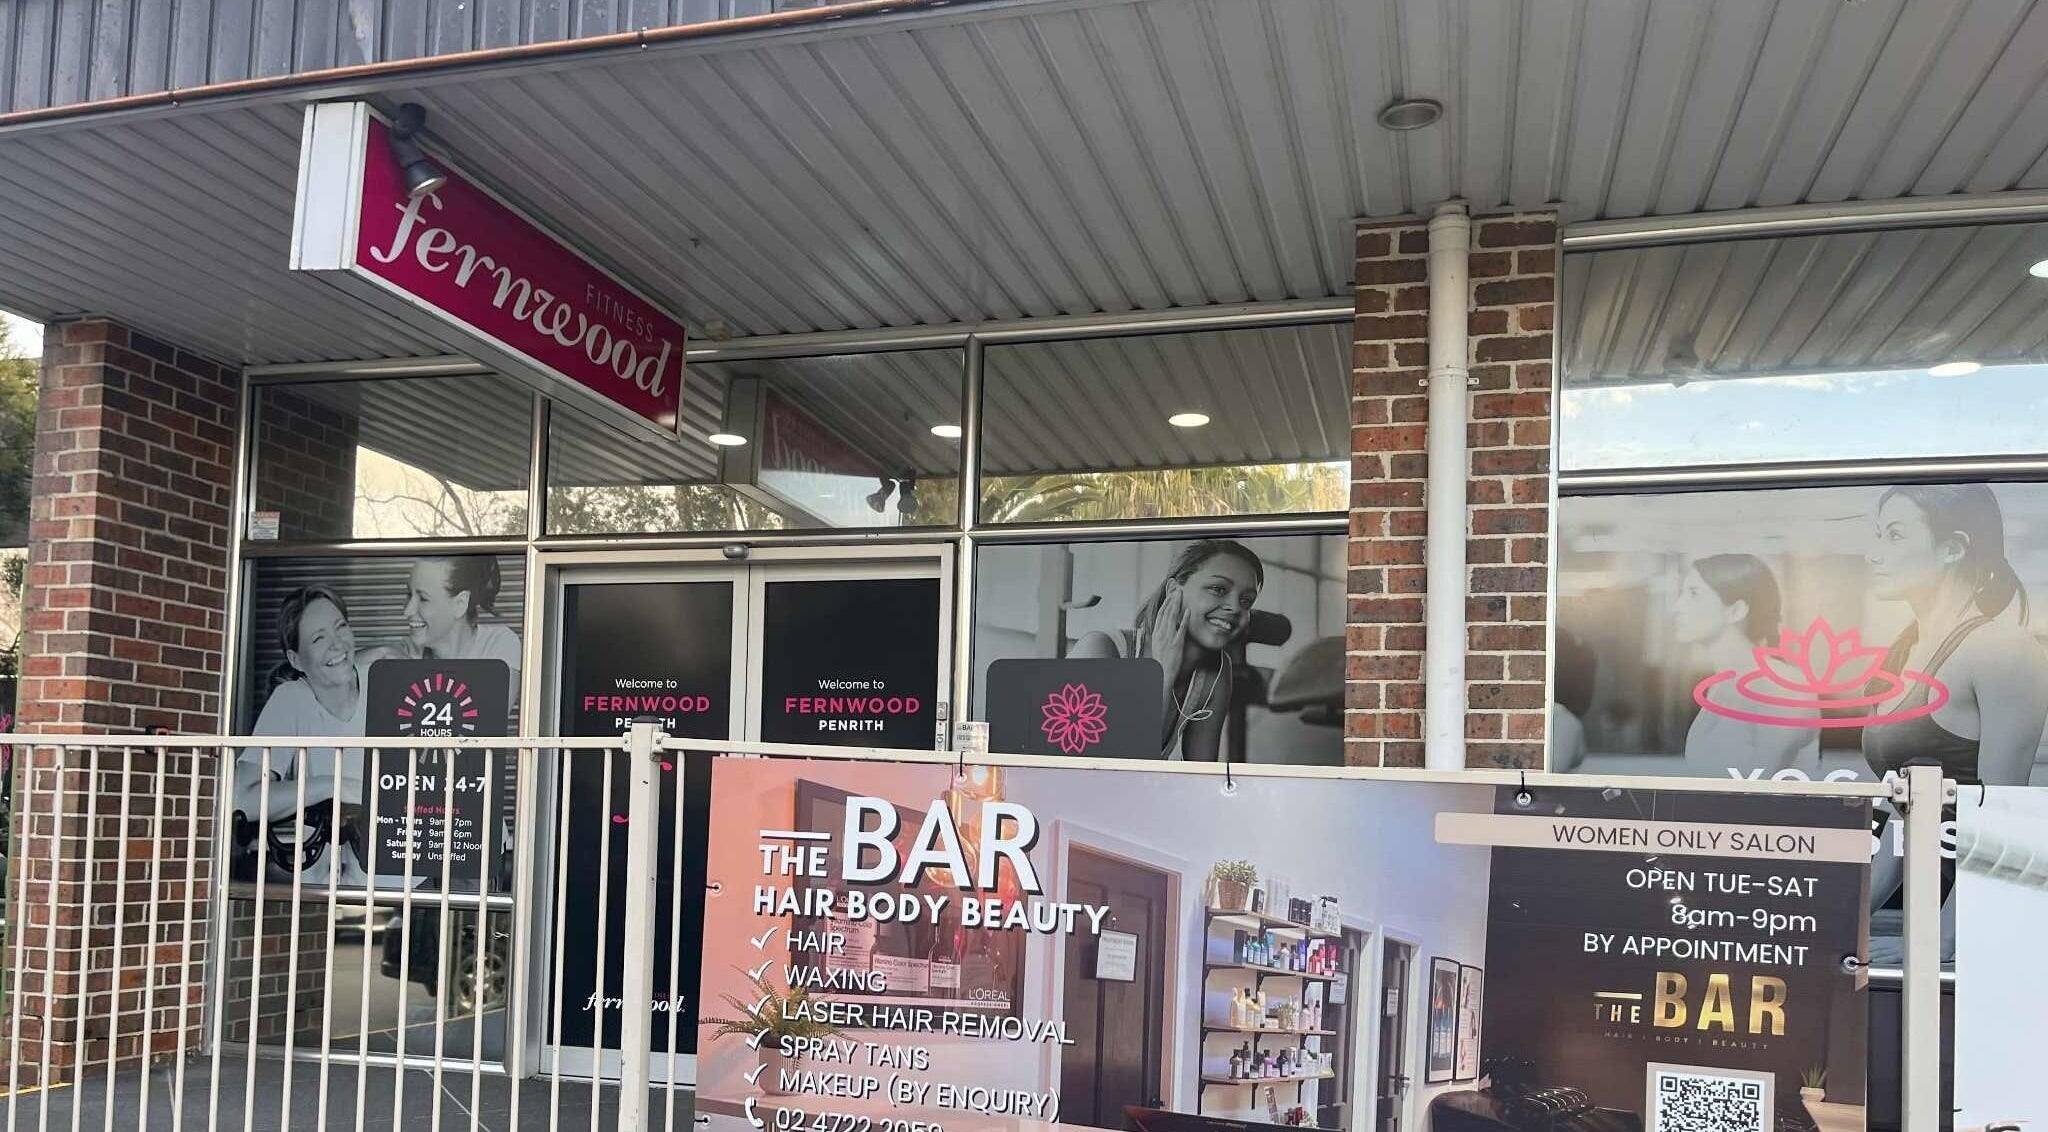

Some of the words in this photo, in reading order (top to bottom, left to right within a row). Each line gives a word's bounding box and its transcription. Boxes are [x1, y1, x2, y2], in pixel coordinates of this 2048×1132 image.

[370, 191, 672, 398] fernwood
[586, 283, 654, 343] FITNESS
[615, 678, 664, 689] Welcome
[666, 679, 678, 689] to
[818, 679, 870, 690] Welcome
[873, 680, 885, 690] to
[420, 702, 453, 726] 24
[584, 696, 710, 712] FERNWOOD
[785, 697, 920, 714] FERNWOOD
[420, 728, 453, 737] HOURS
[615, 718, 676, 729] PETH
[819, 719, 884, 731] PENRITH
[443, 776, 485, 792] 4-7
[377, 815, 394, 824] Mon
[401, 816, 422, 825] Trs
[454, 818, 472, 828] 7pm
[453, 829, 472, 839] 6pm
[453, 841, 462, 850] 12
[842, 796, 1042, 895] BAR
[1552, 823, 1649, 849] WOMEN
[1656, 828, 1722, 852] ONLY
[1731, 831, 1816, 855] SALON
[759, 844, 830, 878] THE
[1626, 868, 1696, 892] OPEN
[1703, 872, 1819, 898] TUE-SAT
[753, 885, 837, 918] HAIR
[848, 890, 953, 924] BODY
[961, 896, 1111, 936] BEAUTY
[1671, 902, 1817, 935] 8am-9pm
[785, 930, 846, 955] HAIR
[1583, 932, 1619, 954] BY
[1622, 936, 1809, 967] APPOINTMENT
[784, 965, 888, 993] WAXING
[1593, 1003, 1641, 1024] THE
[1653, 971, 1787, 1036] BAR
[782, 1001, 864, 1027] LASER
[872, 1008, 934, 1034] HAIR
[942, 1012, 1075, 1045] REMOVAL
[778, 1035, 860, 1064] SPRAY
[864, 1042, 930, 1071] TANS
[779, 1068, 880, 1100] MAKEUP
[887, 1072, 932, 1106] (BY
[936, 1083, 1061, 1122] ENQUIRY)
[776, 1107, 806, 1131] 02
[812, 1111, 872, 1132] 4722
